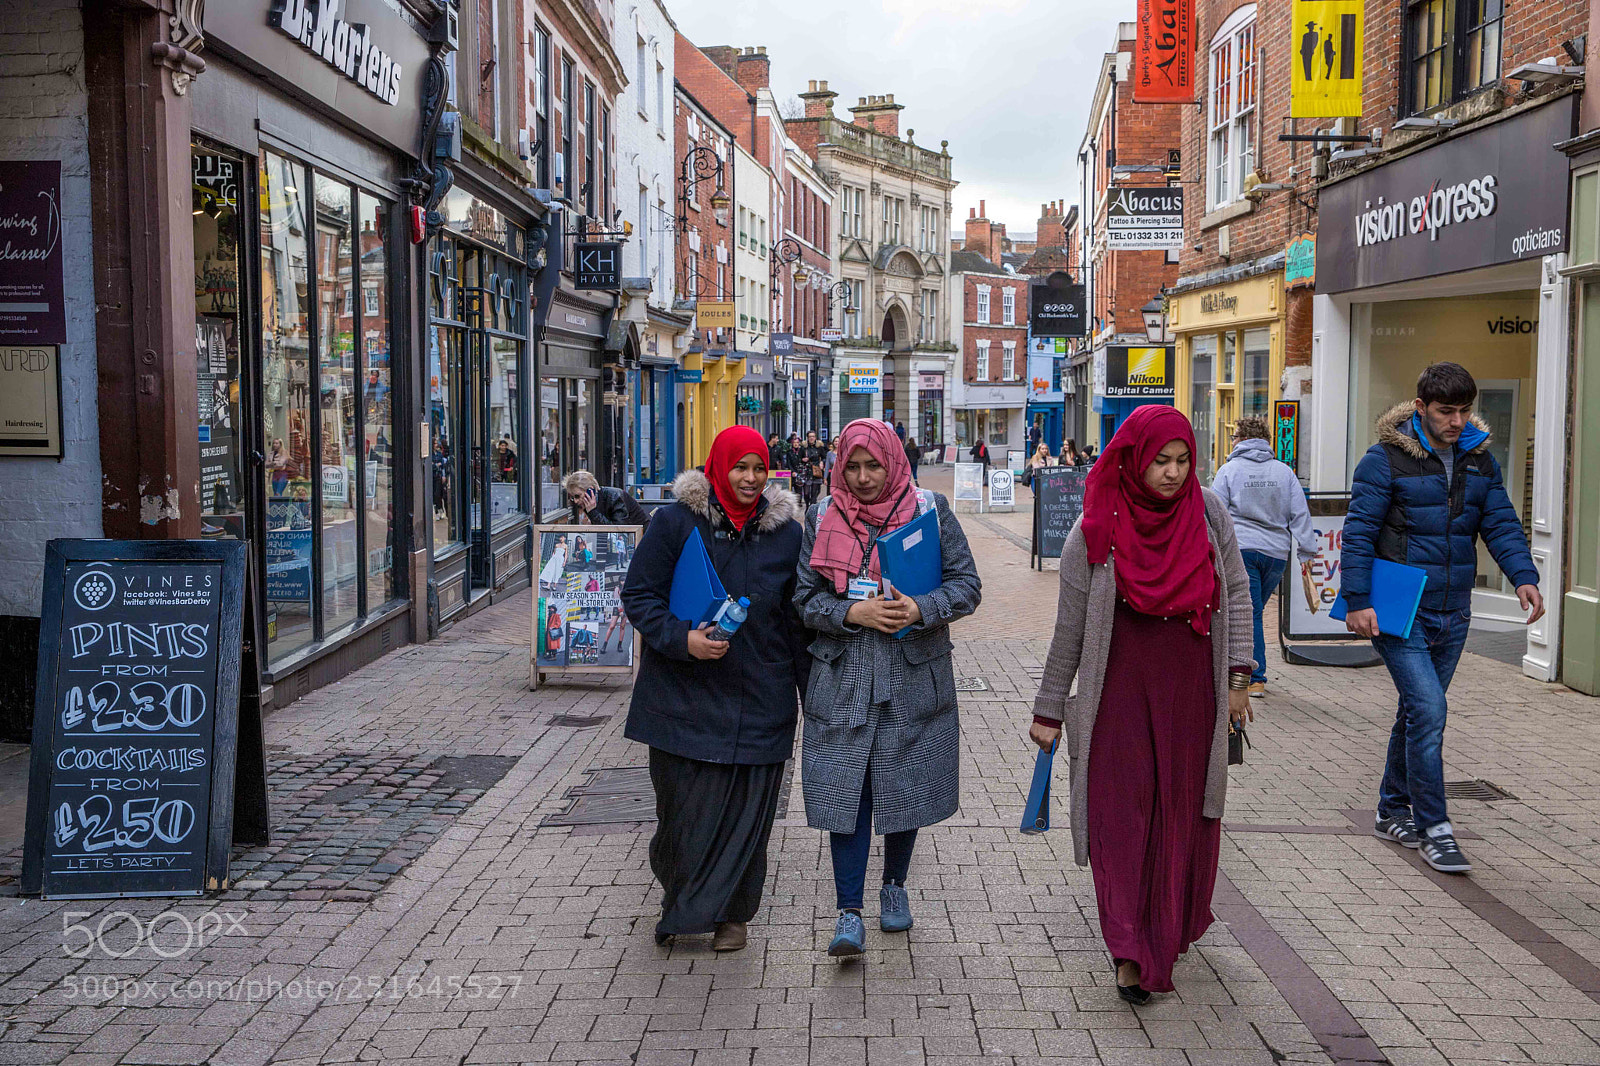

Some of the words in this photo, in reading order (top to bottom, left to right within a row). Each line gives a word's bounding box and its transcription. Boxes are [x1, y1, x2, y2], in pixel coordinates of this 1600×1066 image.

[281, 0, 312, 47] Dr.
[312, 0, 402, 106] Martens
[1142, 26, 1152, 54] Longest
[1156, 0, 1177, 86] Aba
[1142, 56, 1152, 87] Derby's
[195, 154, 232, 178] Dr.
[1109, 188, 1182, 215] Abacus
[1355, 196, 1404, 247] vision
[1410, 174, 1497, 241] express
[0, 213, 37, 236] wing
[1512, 226, 1561, 258] opticians
[580, 250, 614, 272] KH
[1108, 387, 1139, 395] Digital
[1130, 375, 1163, 384] Nikon
[124, 576, 213, 587] VINES
[1311, 555, 1342, 582] Ey
[148, 598, 211, 606] @VinesBarDerby
[69, 622, 209, 659] PINTS
[102, 665, 168, 676] FROM
[61, 681, 206, 732] £2.30
[90, 778, 159, 791] FROM
[54, 794, 195, 852] £2.50
[67, 857, 114, 869] LETS
[121, 856, 176, 868] PARTY
